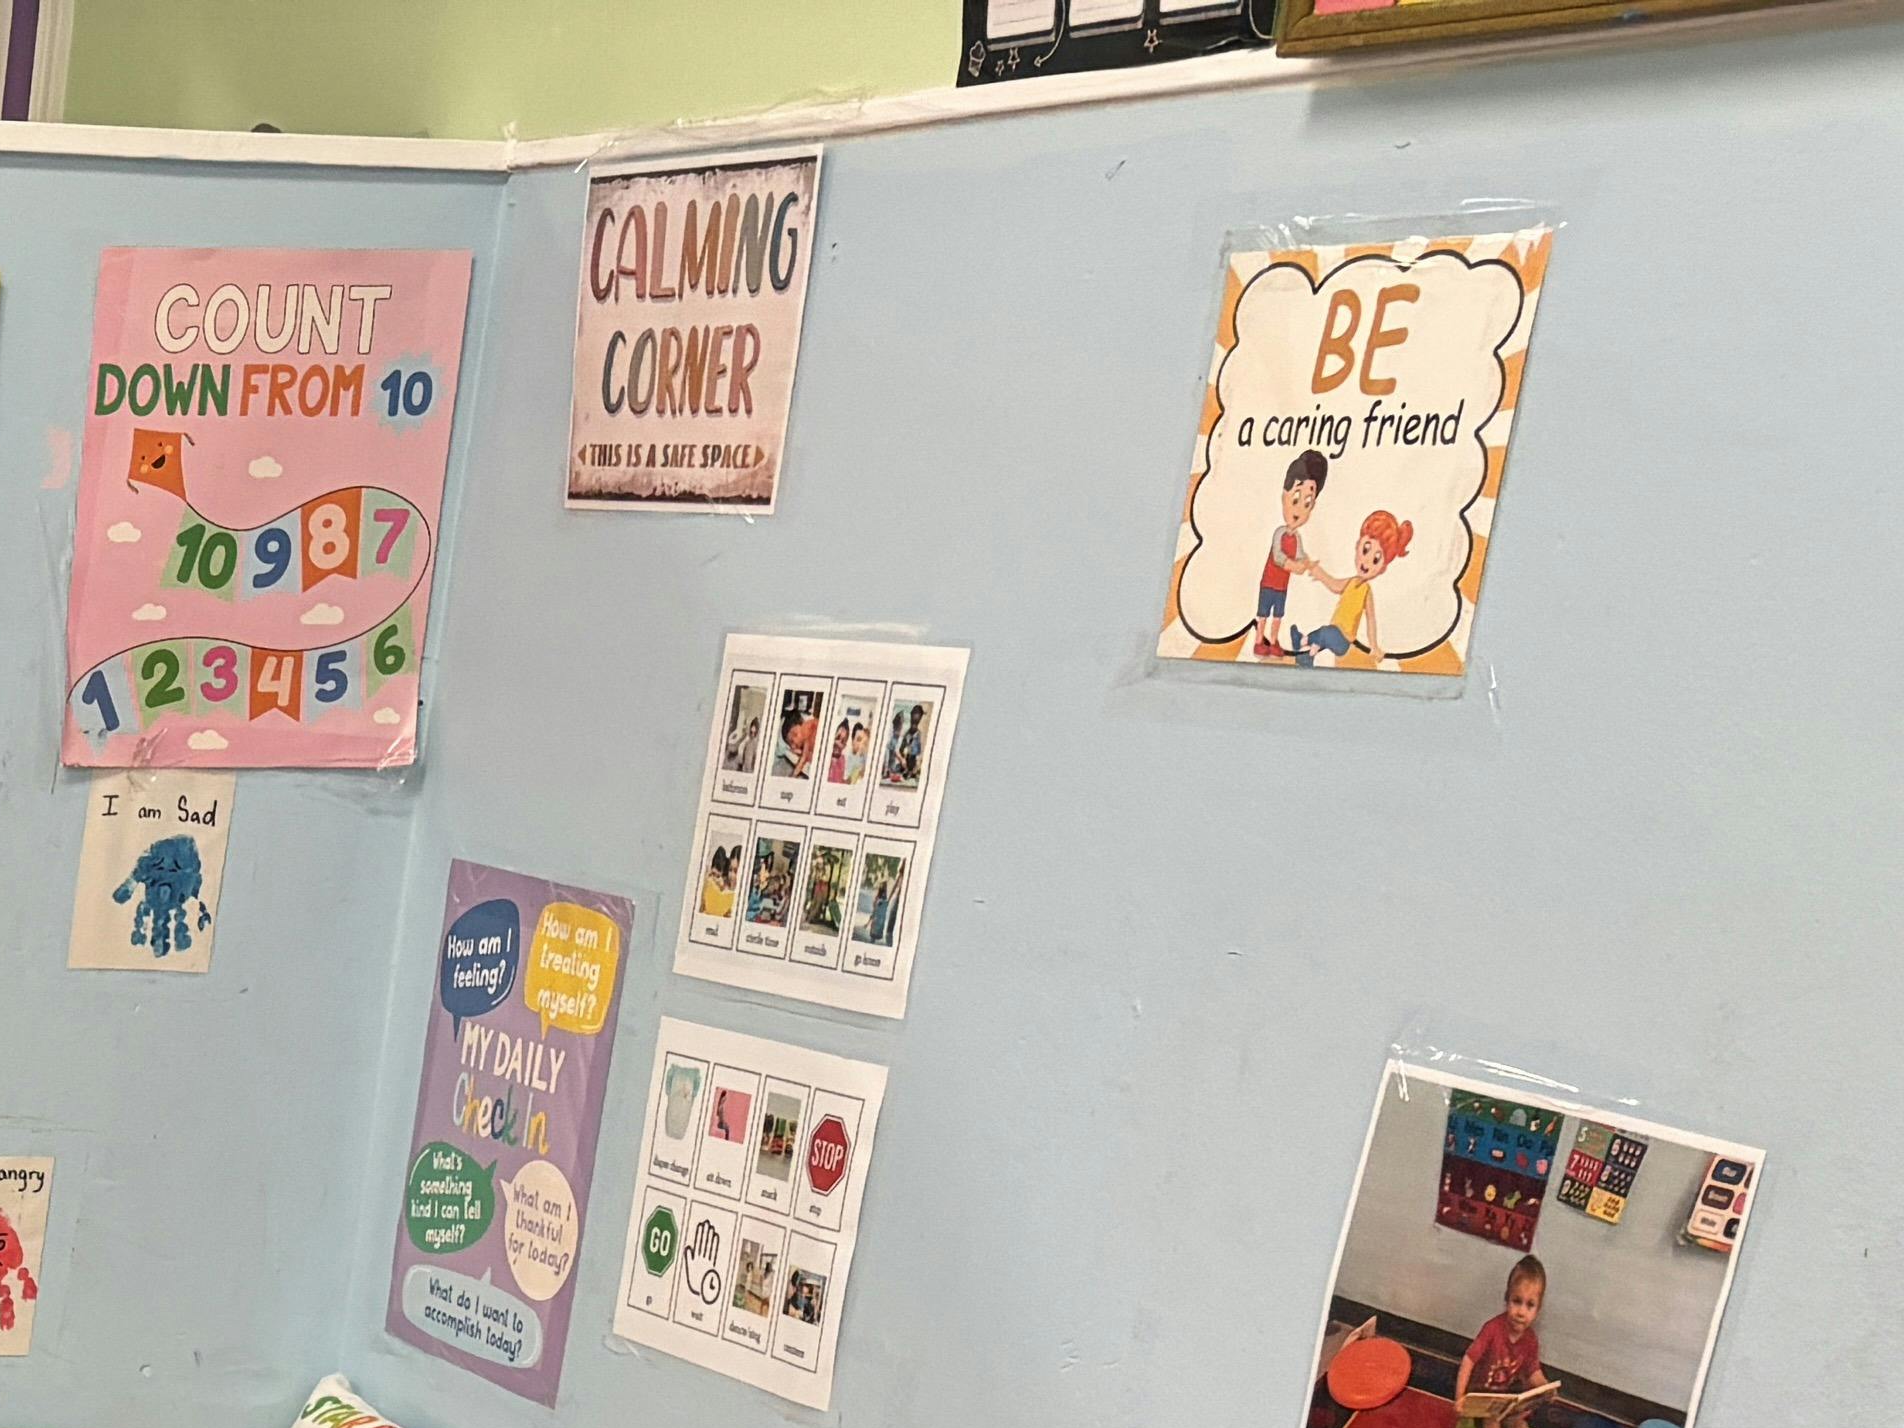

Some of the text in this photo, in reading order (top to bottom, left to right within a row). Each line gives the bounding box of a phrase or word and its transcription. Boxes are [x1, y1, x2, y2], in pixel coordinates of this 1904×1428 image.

[590, 191, 798, 304] CALMING
[154, 283, 392, 355] COUNT
[1311, 283, 1421, 396] BE
[95, 363, 432, 418] DOWN FROM 10
[601, 322, 760, 417] CORNER
[589, 443, 752, 469] THIS IS A SAFE SPACE
[1237, 398, 1465, 460] a caring friend
[101, 794, 218, 827] I am Sad
[447, 928, 512, 959] How am I
[453, 959, 506, 995] feeling?
[461, 1020, 566, 1095] MY DAILY
[811, 1138, 843, 1171] STOP
[649, 1227, 671, 1257] GO
